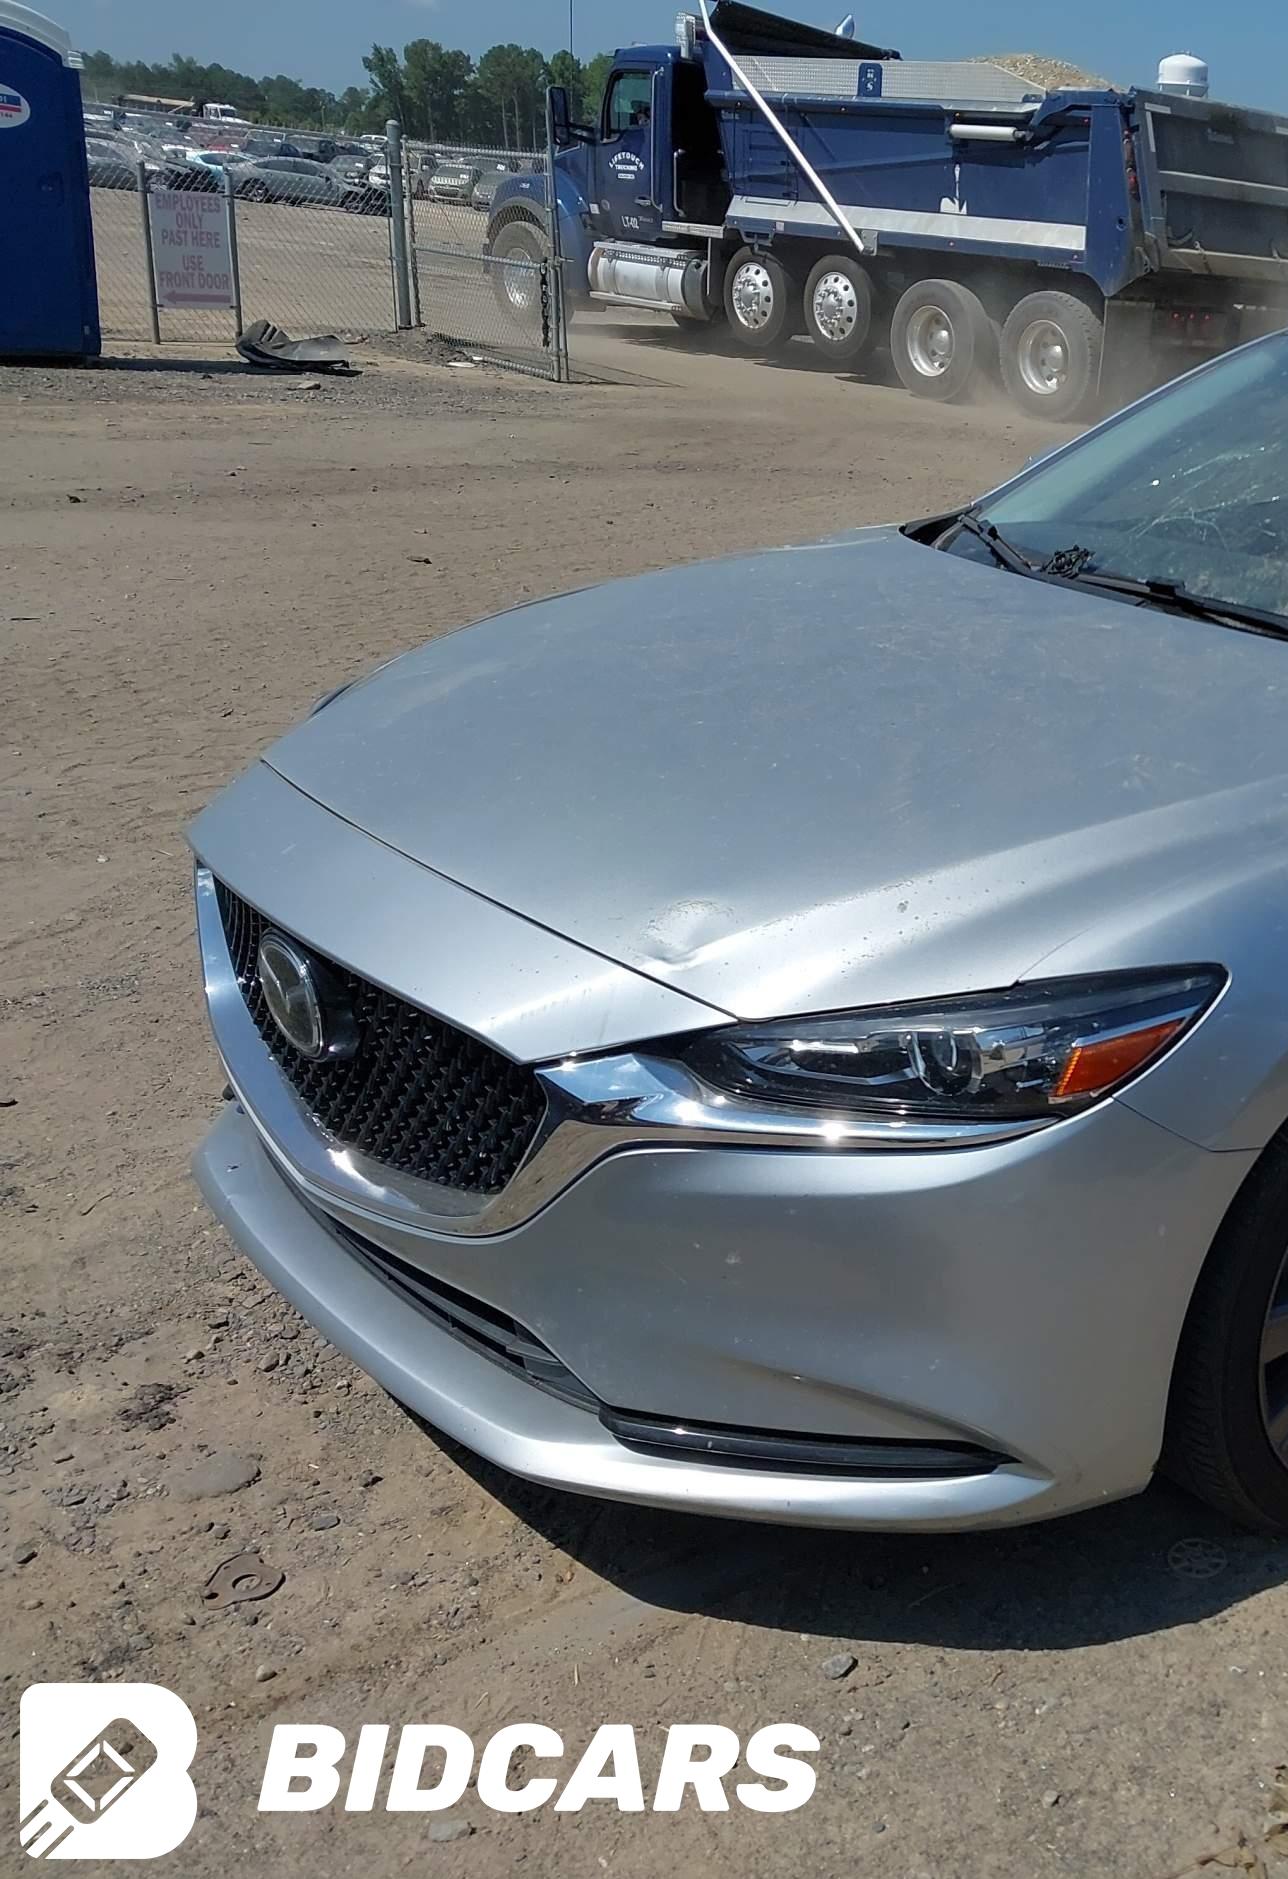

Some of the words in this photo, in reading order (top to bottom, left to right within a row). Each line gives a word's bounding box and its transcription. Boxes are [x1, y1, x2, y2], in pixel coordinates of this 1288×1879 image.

[608, 151, 645, 171] LIFETOUCH
[156, 193, 221, 213] EMPLOYEES
[175, 212, 204, 229] ONLY
[161, 229, 188, 247] PAST
[190, 231, 221, 248] HERE
[182, 255, 205, 271] USE
[160, 271, 197, 288] FRONT
[200, 273, 229, 290] DOOR
